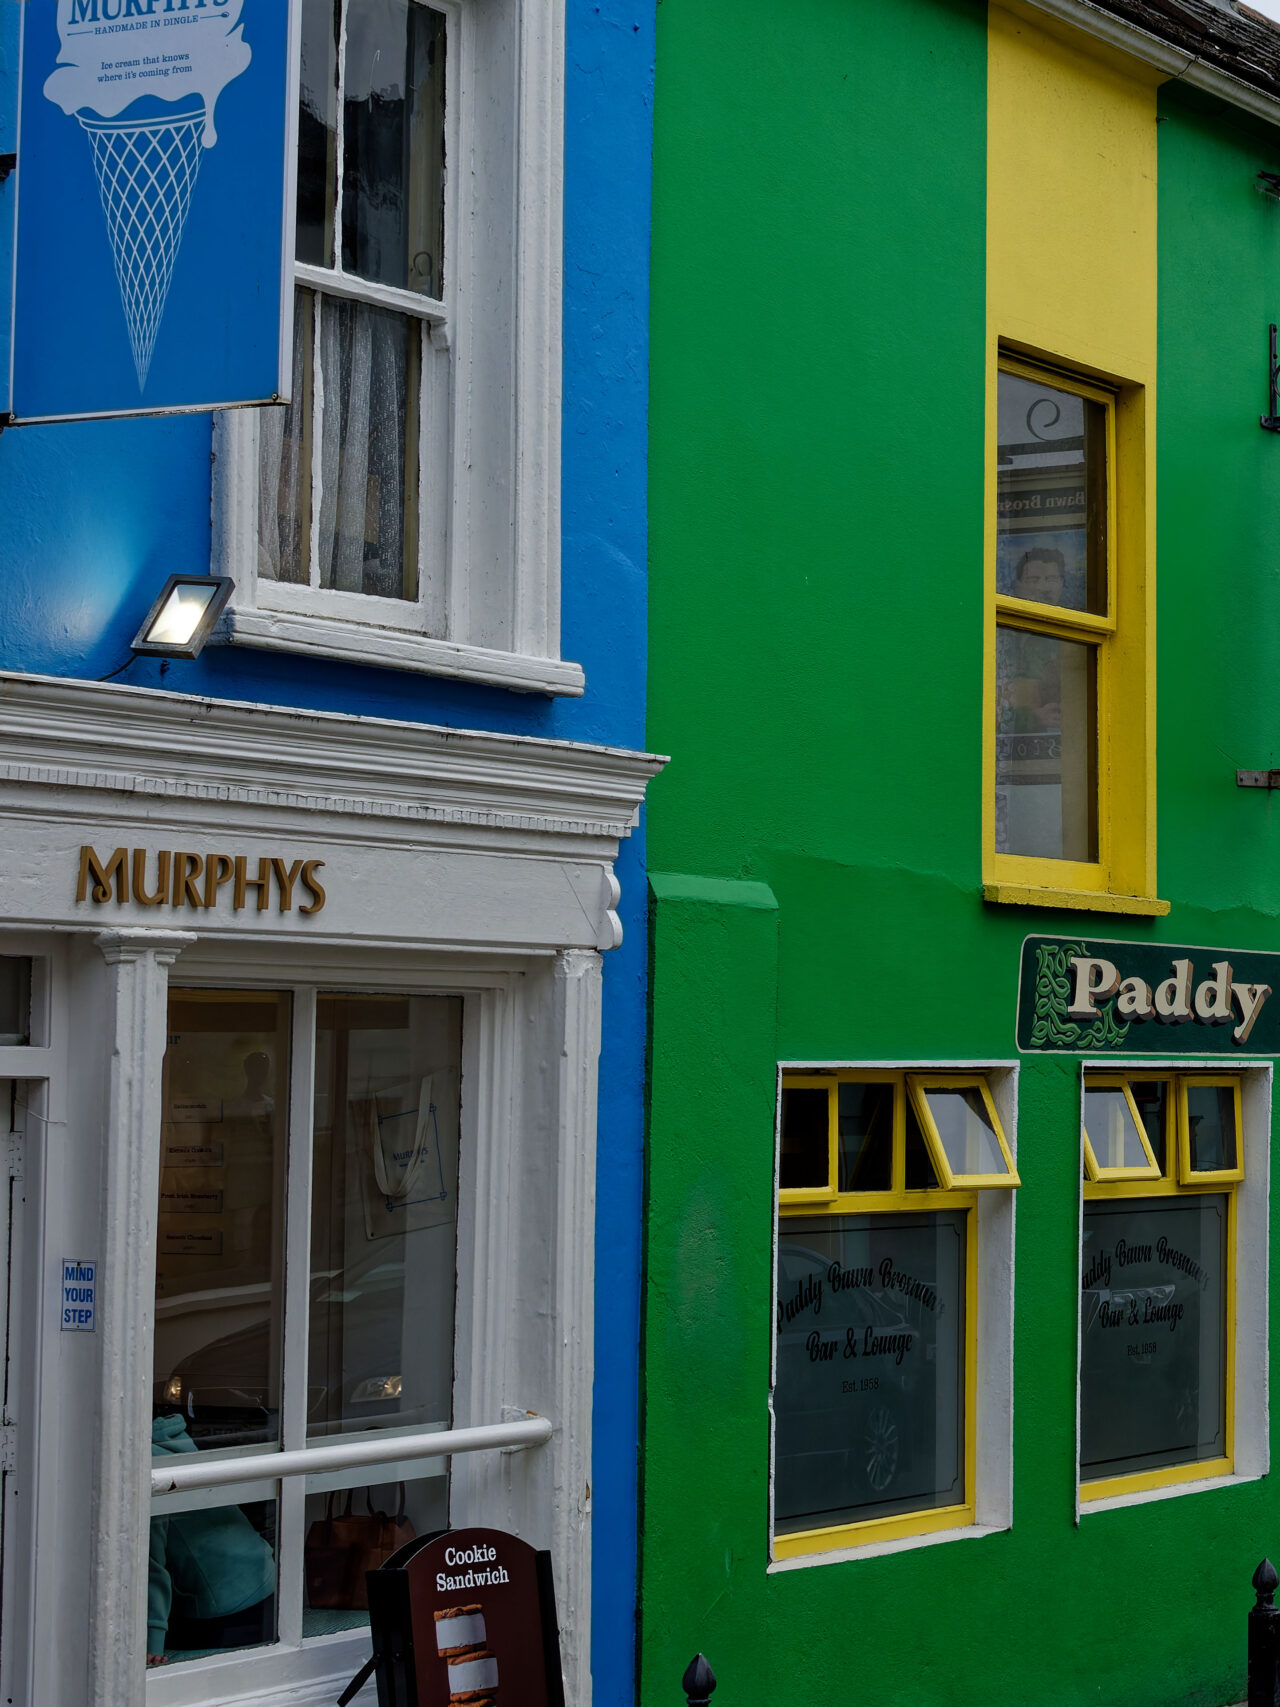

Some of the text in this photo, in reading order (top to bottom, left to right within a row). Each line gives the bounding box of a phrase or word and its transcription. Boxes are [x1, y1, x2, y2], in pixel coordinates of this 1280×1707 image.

[94, 15, 199, 35] HANDMADE IN DINGLE
[101, 53, 190, 71] Ice cream that knows
[97, 64, 193, 83] where it's coming from
[76, 846, 326, 914] MURPHYS
[1067, 957, 1273, 1044] Paddy
[1115, 1239, 1152, 1267] Bawn
[64, 1266, 94, 1281] MIND
[827, 1260, 875, 1293] Bawn
[64, 1287, 93, 1303] YOUR
[64, 1308, 92, 1324] STEP
[1099, 1297, 1184, 1332] Bar & Lounge
[806, 1326, 913, 1366] Bar & Lounge
[841, 1376, 880, 1394] Est. 1958
[445, 1544, 497, 1566] Cookie
[436, 1566, 510, 1592] Sandwich
